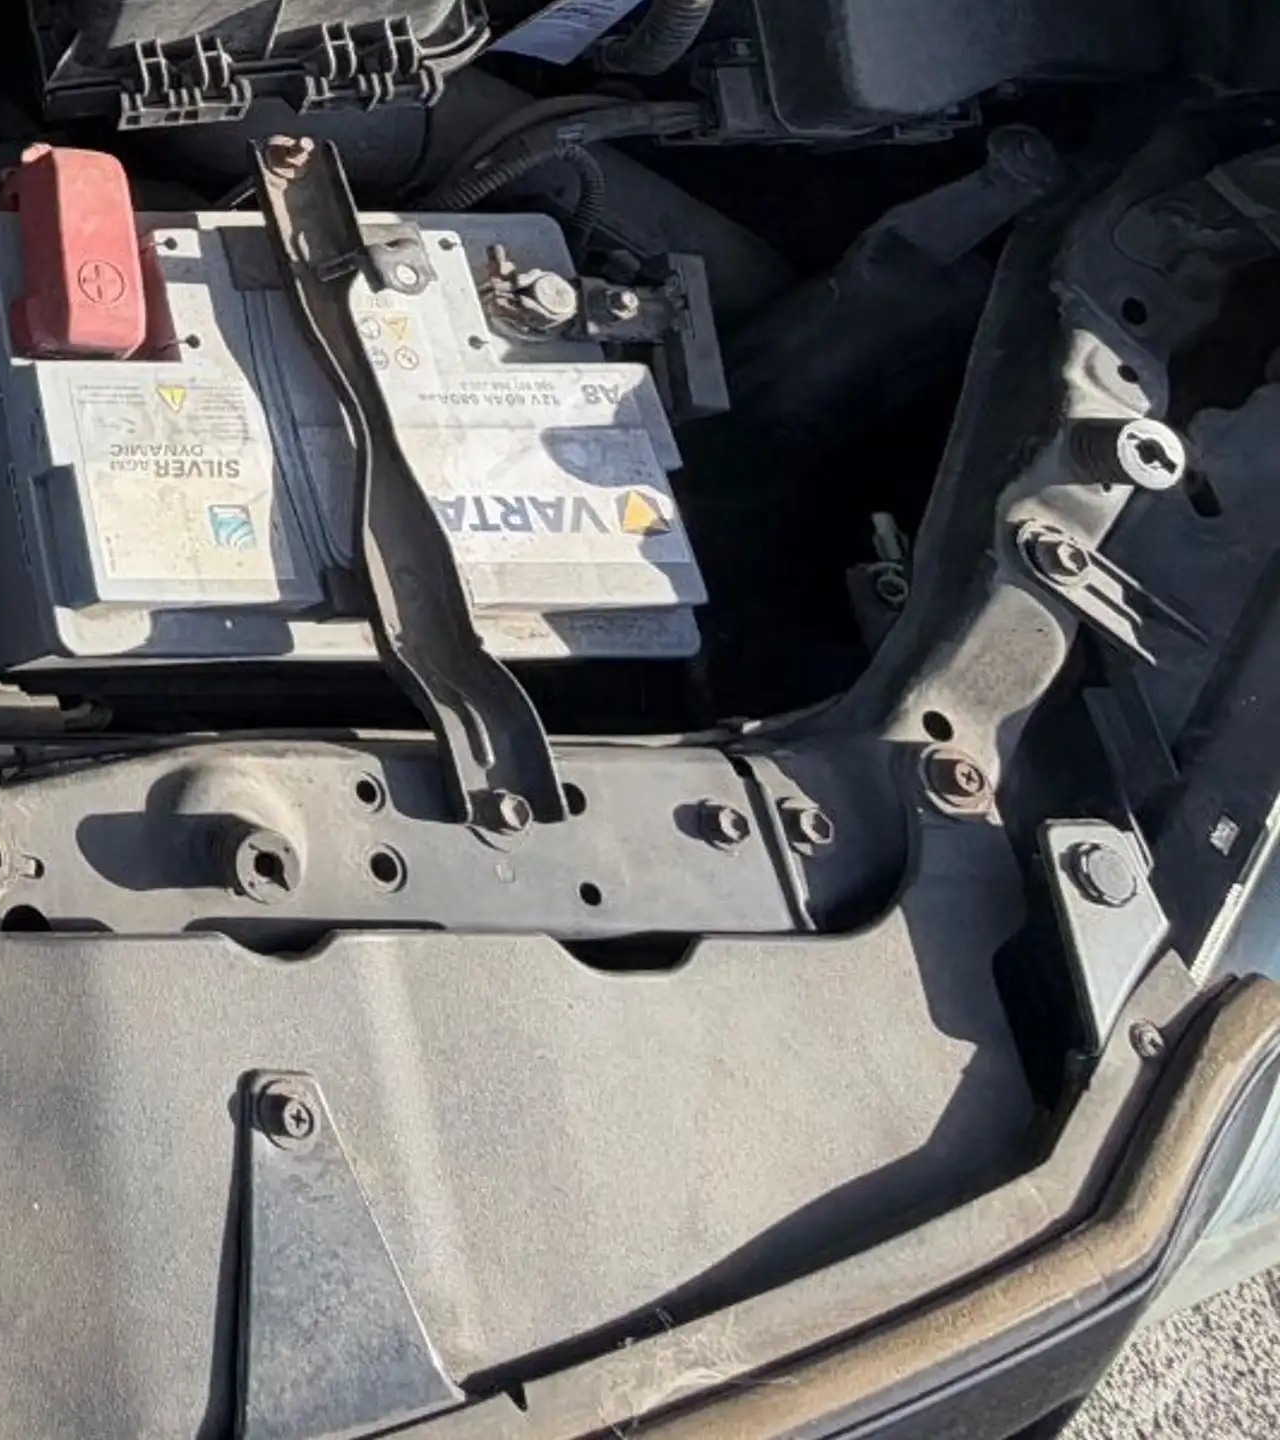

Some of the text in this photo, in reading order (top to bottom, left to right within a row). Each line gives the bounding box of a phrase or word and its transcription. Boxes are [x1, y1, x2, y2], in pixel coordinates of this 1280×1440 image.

[580, 383, 621, 405] A8
[110, 443, 204, 457] DYNAMIC
[109, 459, 241, 479] SILVER AGM
[430, 495, 610, 533] VARTA
